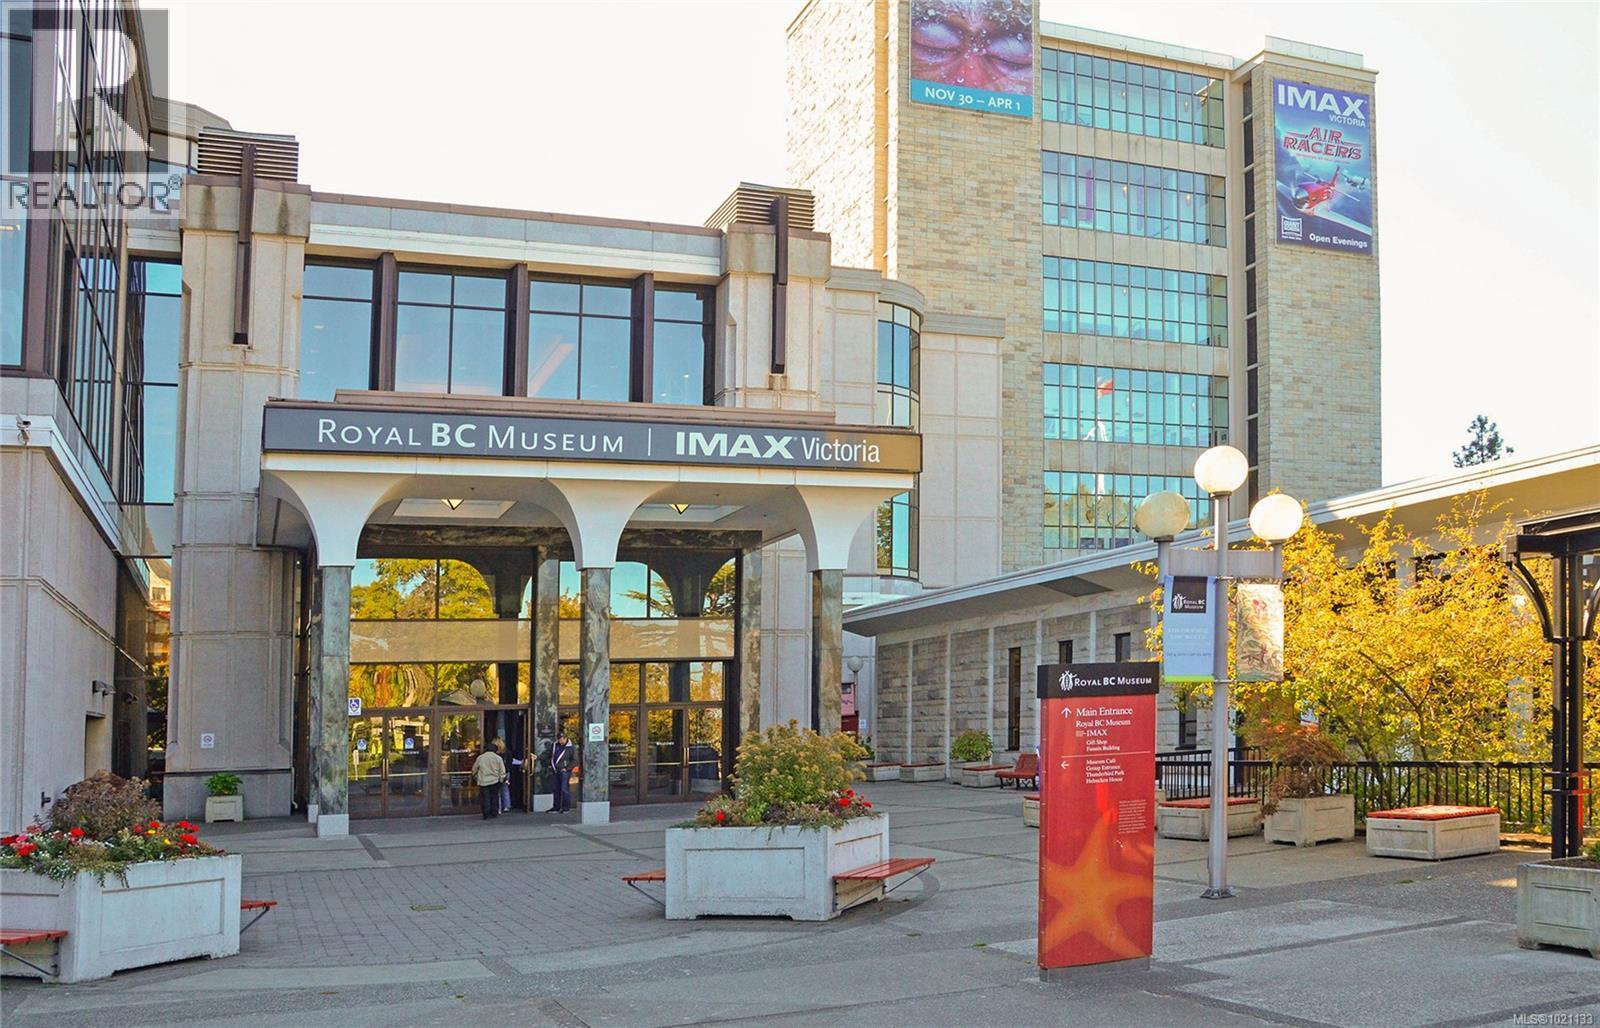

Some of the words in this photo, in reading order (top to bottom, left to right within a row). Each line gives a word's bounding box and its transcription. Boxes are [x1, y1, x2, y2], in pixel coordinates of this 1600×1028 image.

[925, 87, 956, 101] NOV
[959, 94, 974, 106] 30
[988, 97, 1013, 110] APR
[1015, 102, 1021, 111] 1
[1277, 84, 1366, 120] IMAX
[1328, 114, 1367, 127] VICTORIA
[1309, 127, 1343, 143] AIR
[1283, 136, 1362, 160] RACERS
[1309, 233, 1331, 243] Open
[1332, 236, 1368, 249] Evenings
[431, 422, 477, 448] BC
[676, 431, 795, 460] IMAX
[801, 436, 881, 463] Victoria
[1103, 677, 1116, 686] BC
[1076, 707, 1098, 717] Main
[1099, 706, 1133, 716] Entrance
[1075, 719, 1094, 728] Royal
[1094, 719, 1105, 727] BC
